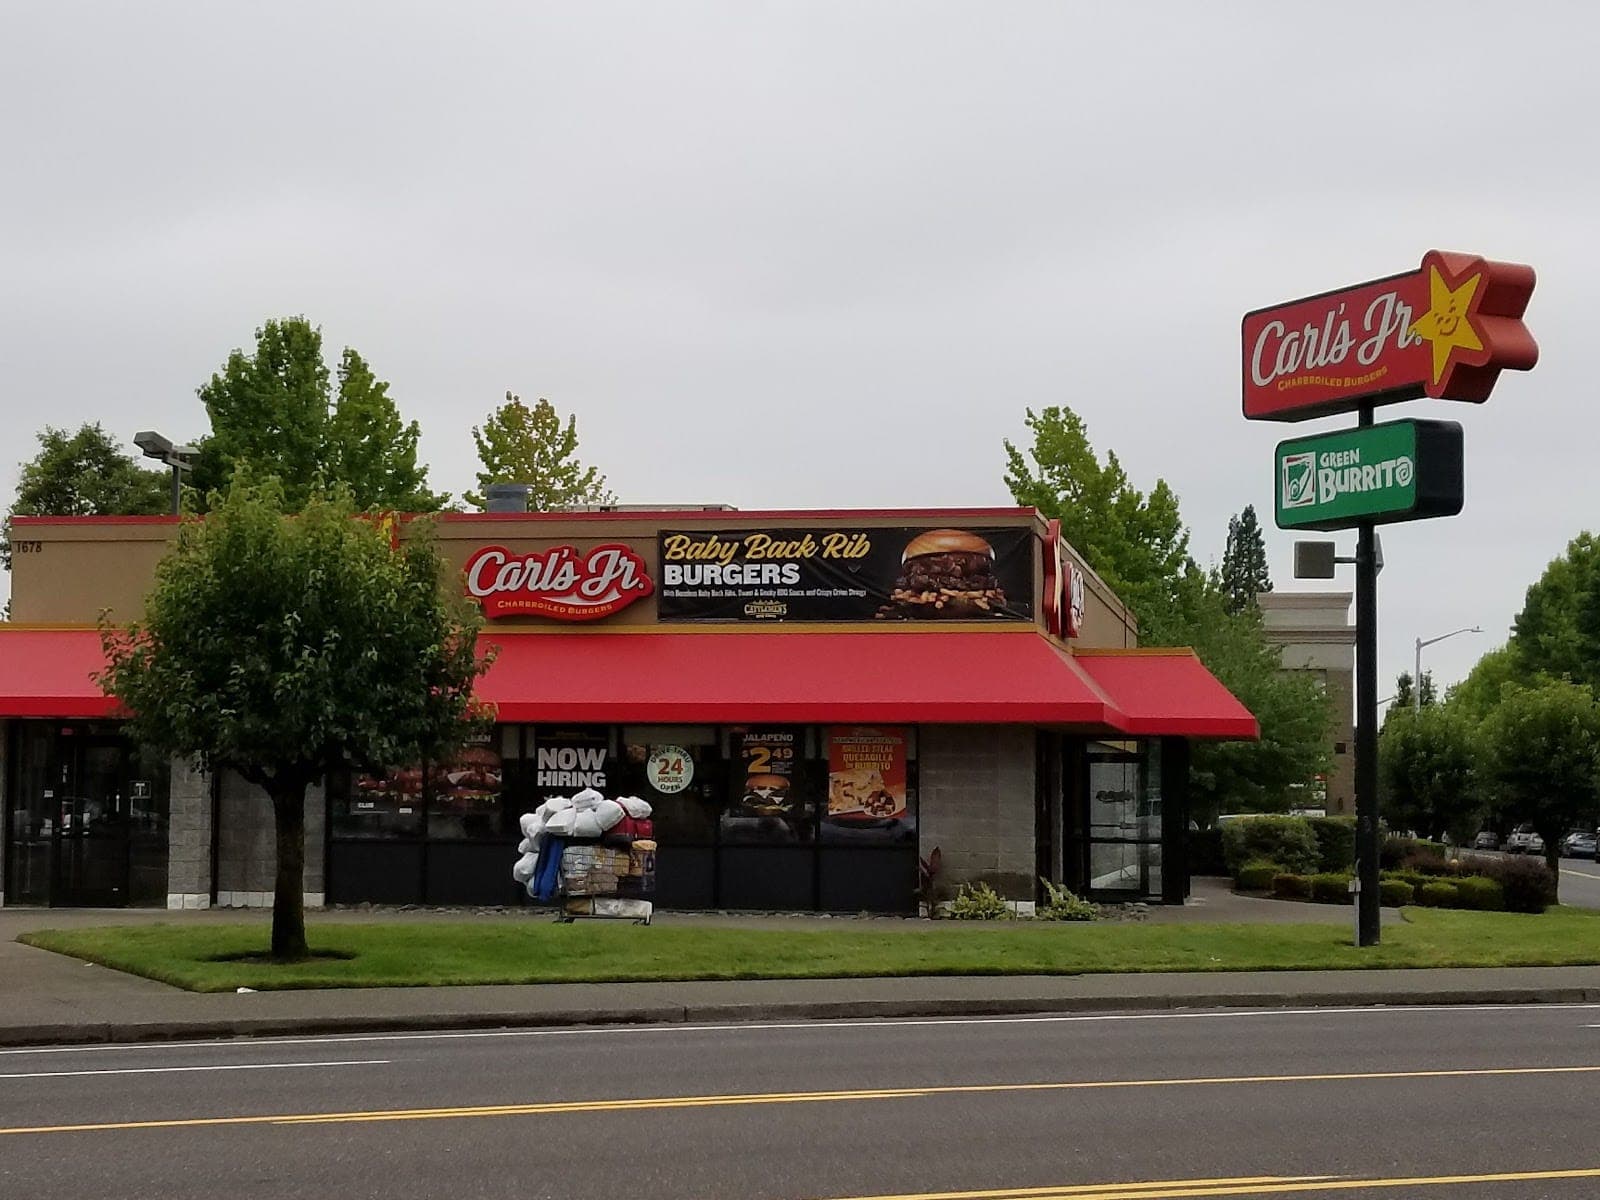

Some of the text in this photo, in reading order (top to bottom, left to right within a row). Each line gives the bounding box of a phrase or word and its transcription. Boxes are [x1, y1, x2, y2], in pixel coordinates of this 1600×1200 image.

[1252, 292, 1422, 386] Carl's Jr.
[1278, 365, 1388, 391] CHARBROILED BURGERS
[1320, 448, 1359, 467] GREEN
[1318, 456, 1413, 504] BURRITO
[17, 541, 42, 553] 1678
[664, 533, 871, 566] Baby Back Rib
[468, 549, 645, 596] Carl's Jr.
[664, 563, 800, 585] BURGERS
[498, 600, 612, 615] CHARBROILED BURGERS
[538, 747, 607, 770] NOW
[658, 758, 684, 774] 24
[537, 771, 607, 787] HIRING
